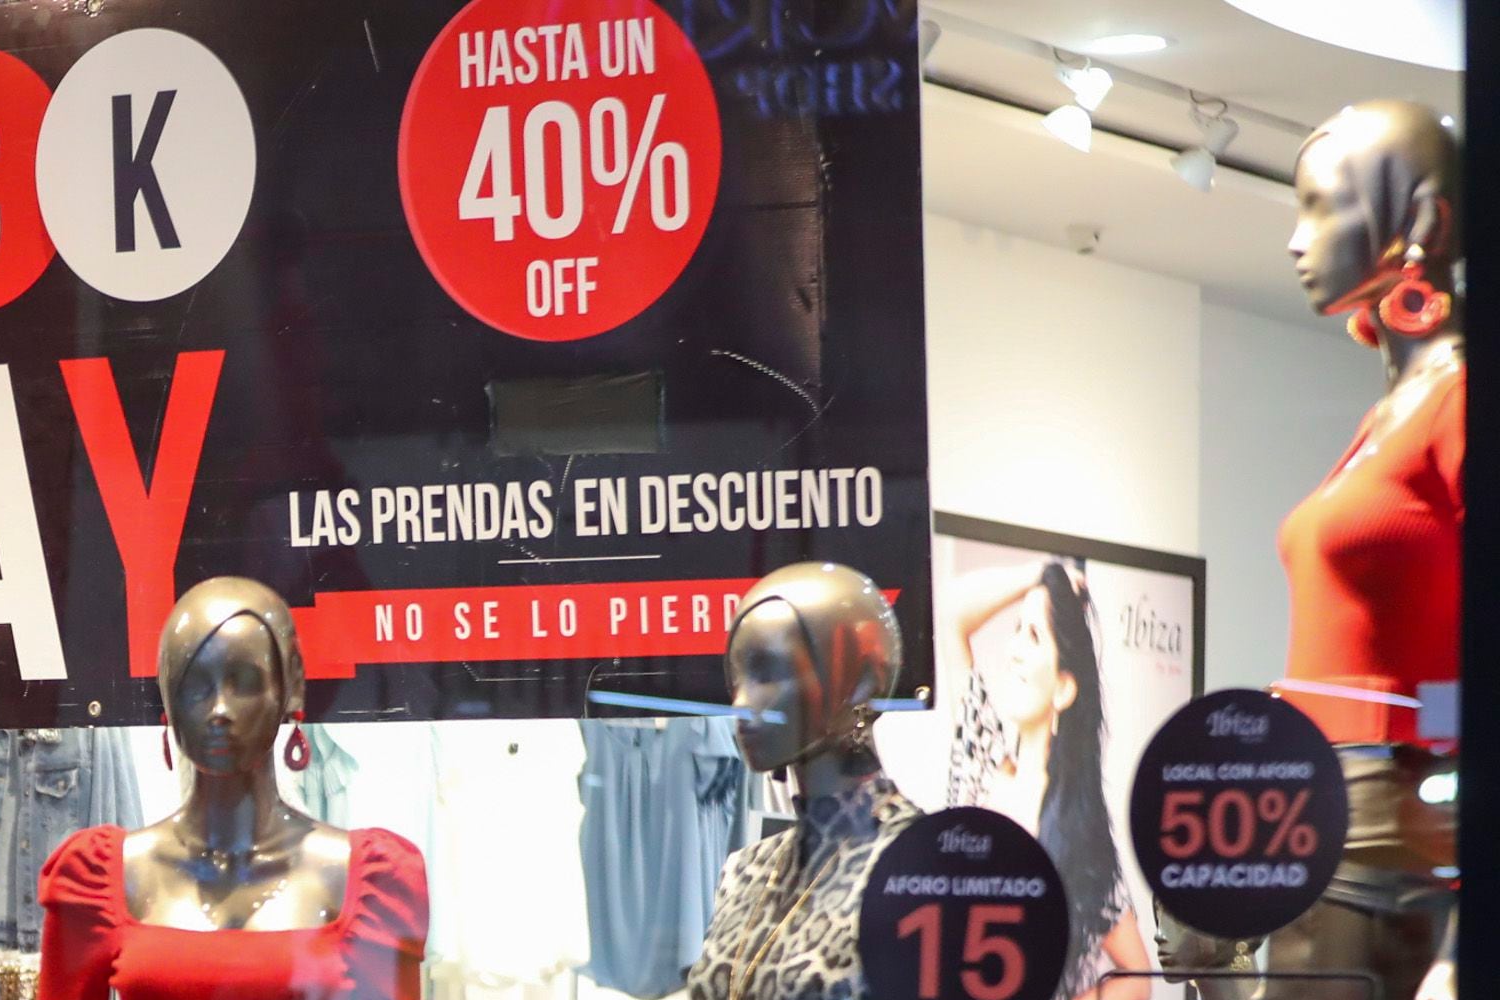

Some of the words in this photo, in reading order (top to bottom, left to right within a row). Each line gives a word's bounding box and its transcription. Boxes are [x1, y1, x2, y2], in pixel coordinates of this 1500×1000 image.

[459, 24, 588, 89] HASTA
[599, 17, 655, 79] UN
[457, 94, 690, 242] 40%
[526, 256, 598, 318] OFF
[289, 488, 362, 549] LAS
[372, 477, 554, 544] PRENDAS
[574, 476, 628, 538] EN
[640, 466, 883, 536] DESCUENTO
[375, 602, 423, 643] NO
[454, 600, 501, 641] SE
[531, 597, 579, 638] LO
[609, 592, 740, 635] PIERD
[1162, 763, 1216, 782] LOCAL
[1217, 762, 1255, 781] CON
[1159, 788, 1319, 859] 50%
[883, 875, 949, 896] AFORO
[952, 876, 1046, 898] LIMITADO
[1160, 863, 1308, 889] CAPACIDAD
